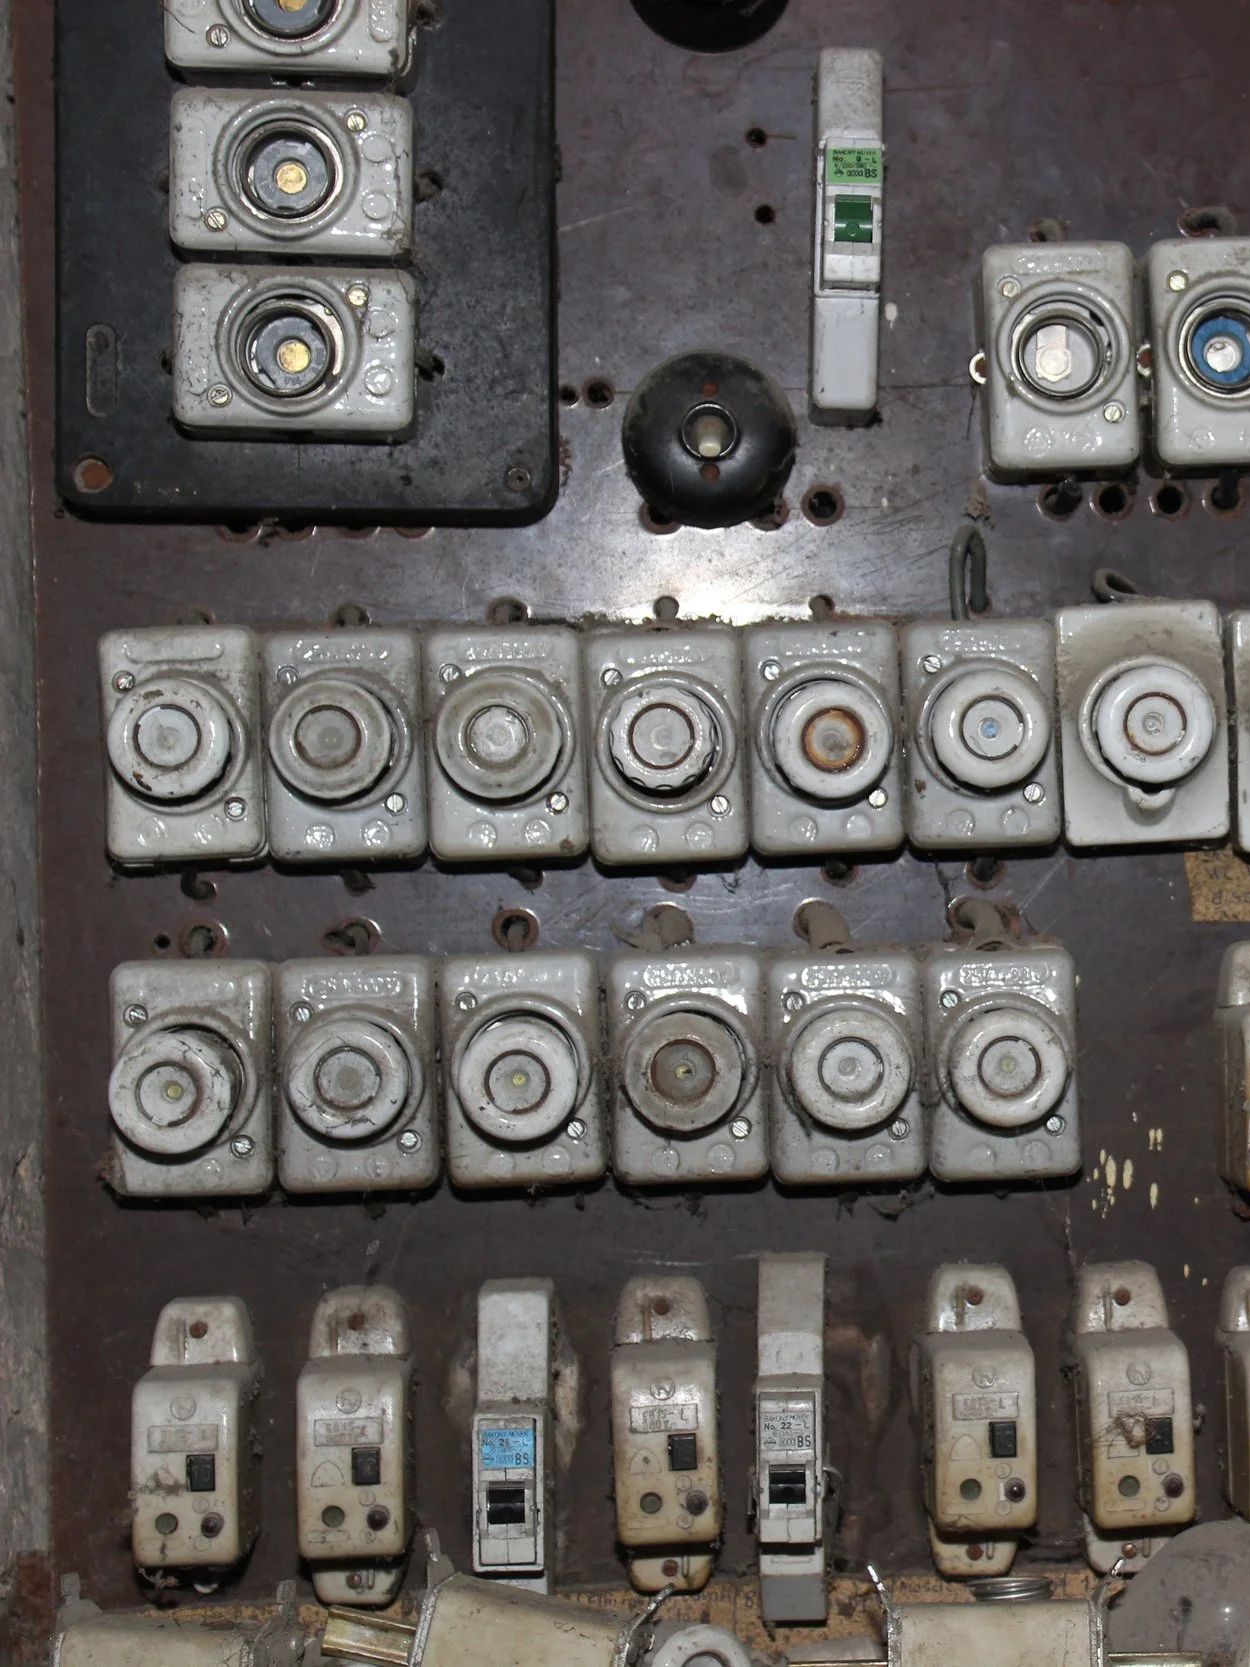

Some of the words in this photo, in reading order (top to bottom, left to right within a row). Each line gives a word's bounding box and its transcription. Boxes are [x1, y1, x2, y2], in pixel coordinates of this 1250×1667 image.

[864, 168, 878, 178] BS
[780, 1421, 792, 1430] 22
[797, 1435, 812, 1448] BS
[515, 1452, 530, 1466] BS
